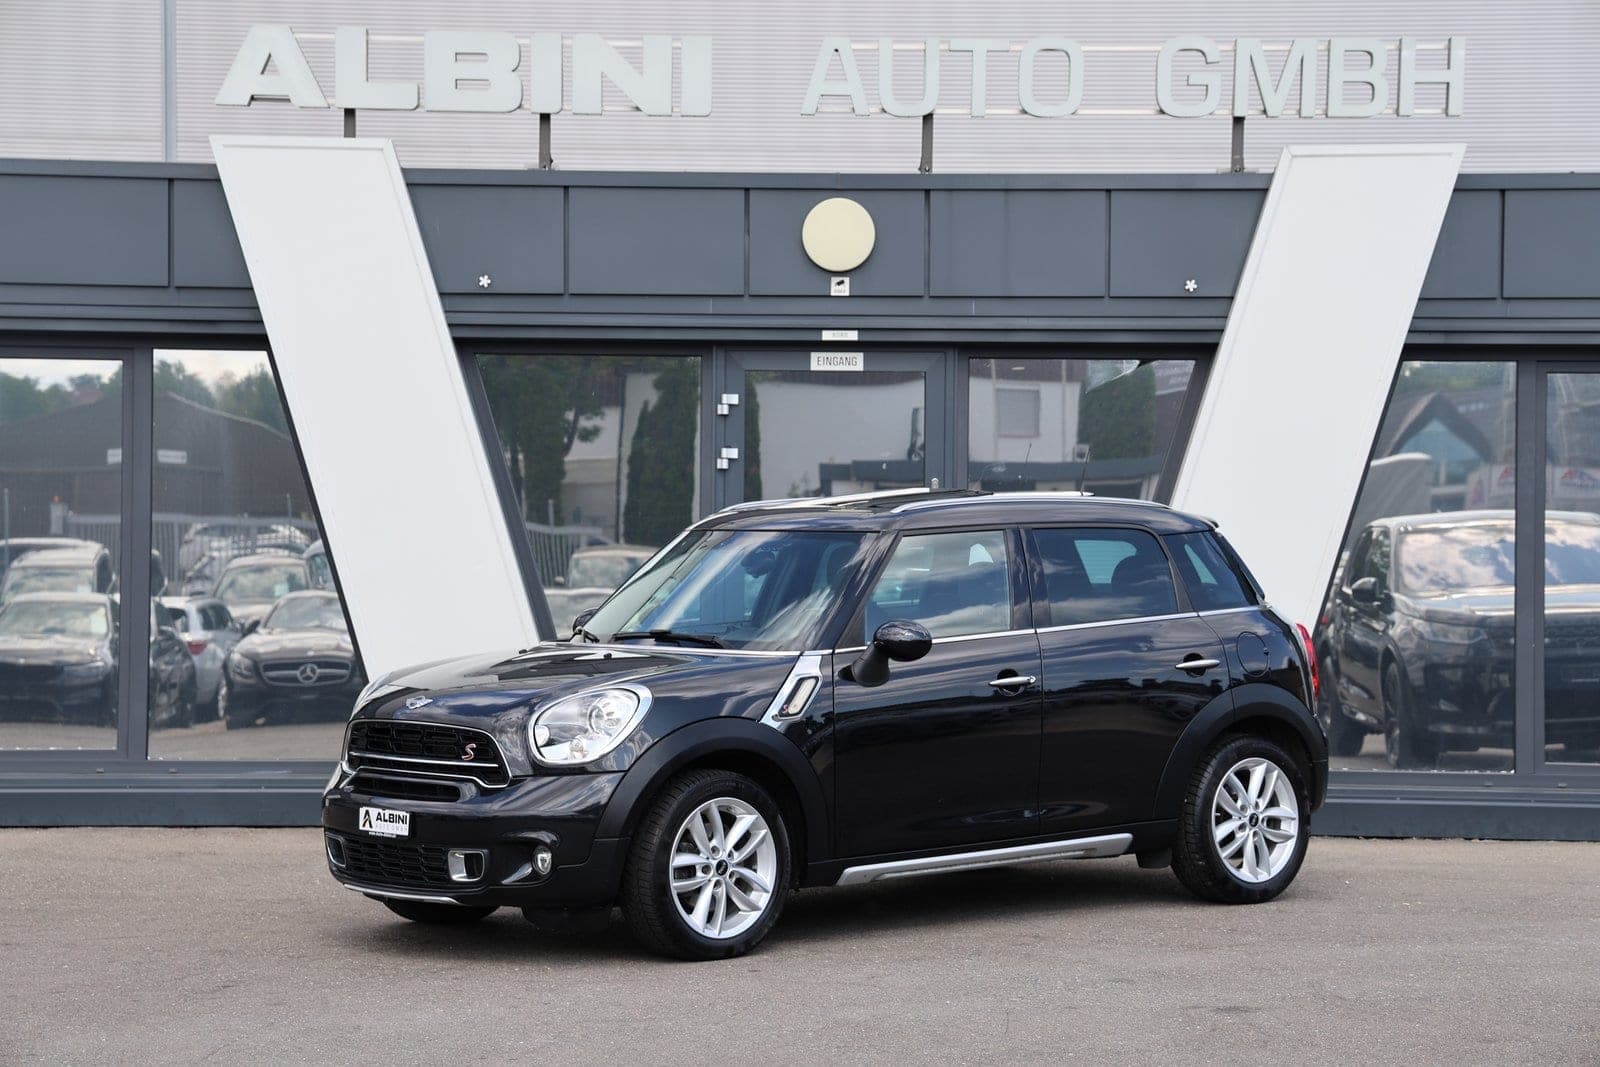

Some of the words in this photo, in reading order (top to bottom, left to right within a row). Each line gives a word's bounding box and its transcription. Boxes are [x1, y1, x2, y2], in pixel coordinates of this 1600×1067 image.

[215, 24, 712, 116] ALBINI
[801, 36, 1084, 118] AUTO
[1155, 36, 1466, 118] GMBH
[816, 356, 858, 367] EINGANG
[461, 743, 477, 761] S
[375, 811, 408, 825] ALBINI
